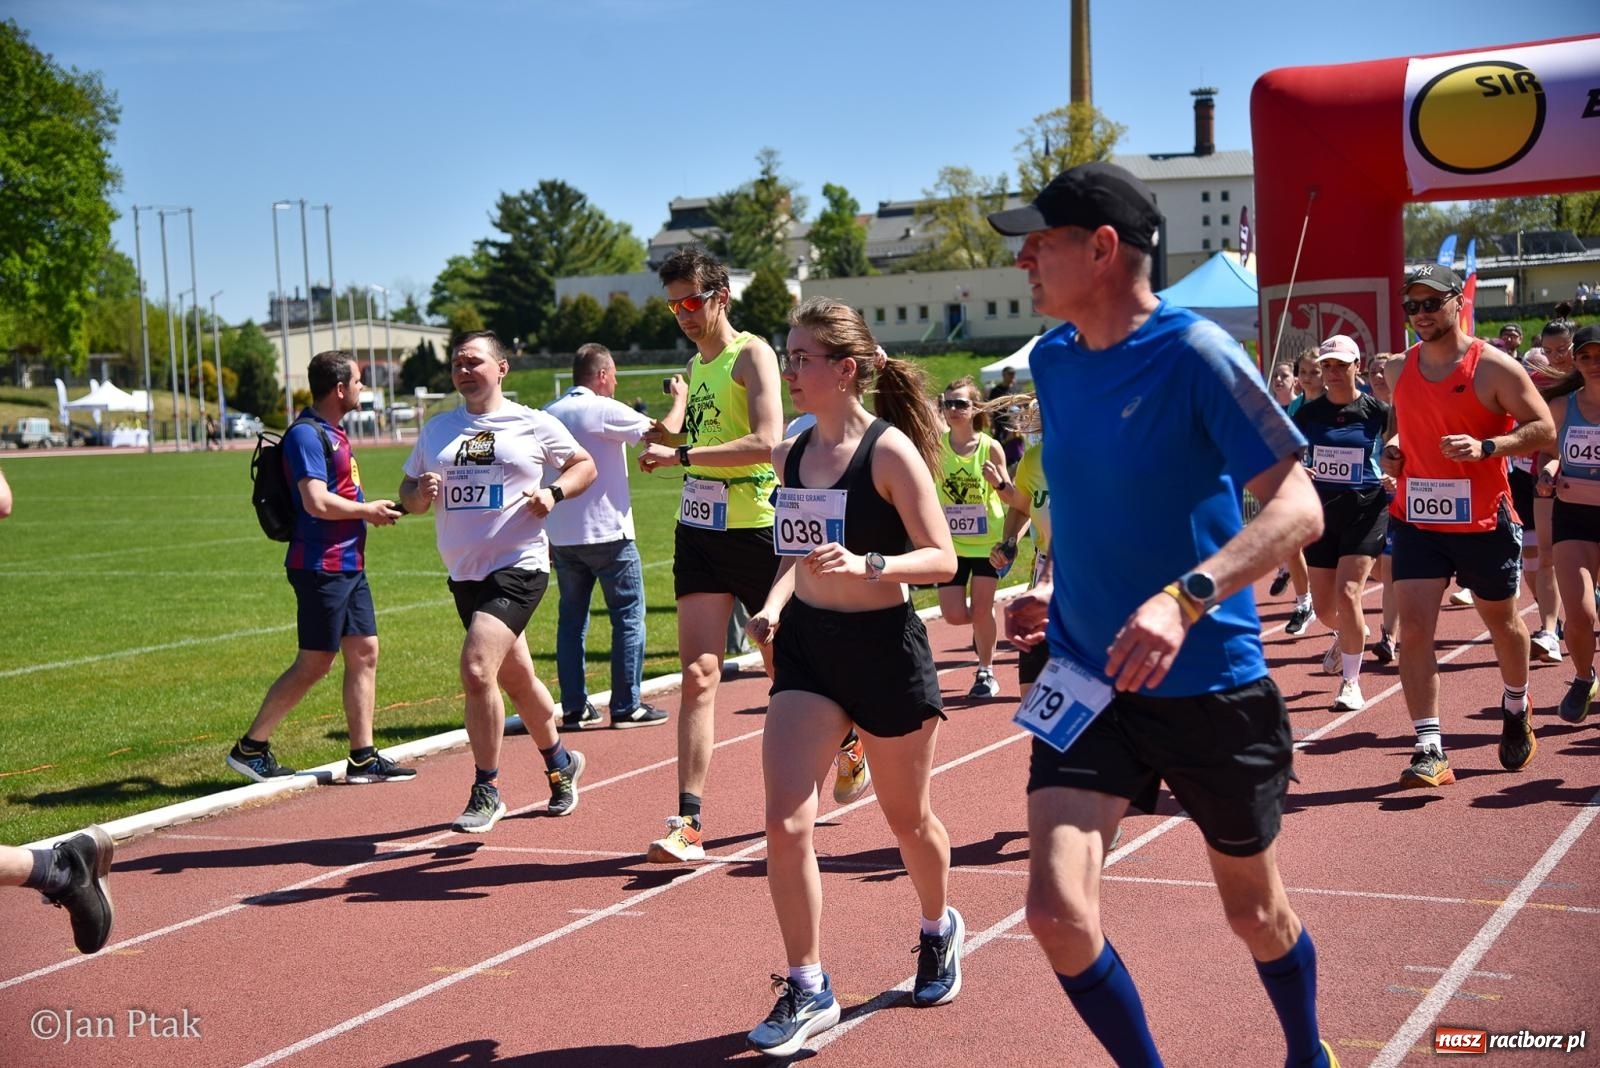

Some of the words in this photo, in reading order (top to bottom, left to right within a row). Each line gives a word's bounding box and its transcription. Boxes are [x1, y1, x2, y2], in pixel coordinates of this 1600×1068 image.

[1475, 71, 1542, 97] SIR
[1570, 444, 1600, 460] 049
[1318, 462, 1349, 476] 050
[451, 486, 486, 503] 037
[684, 499, 710, 520] 069
[1414, 498, 1452, 515] 060
[781, 518, 823, 545] 038
[950, 518, 975, 530] 067
